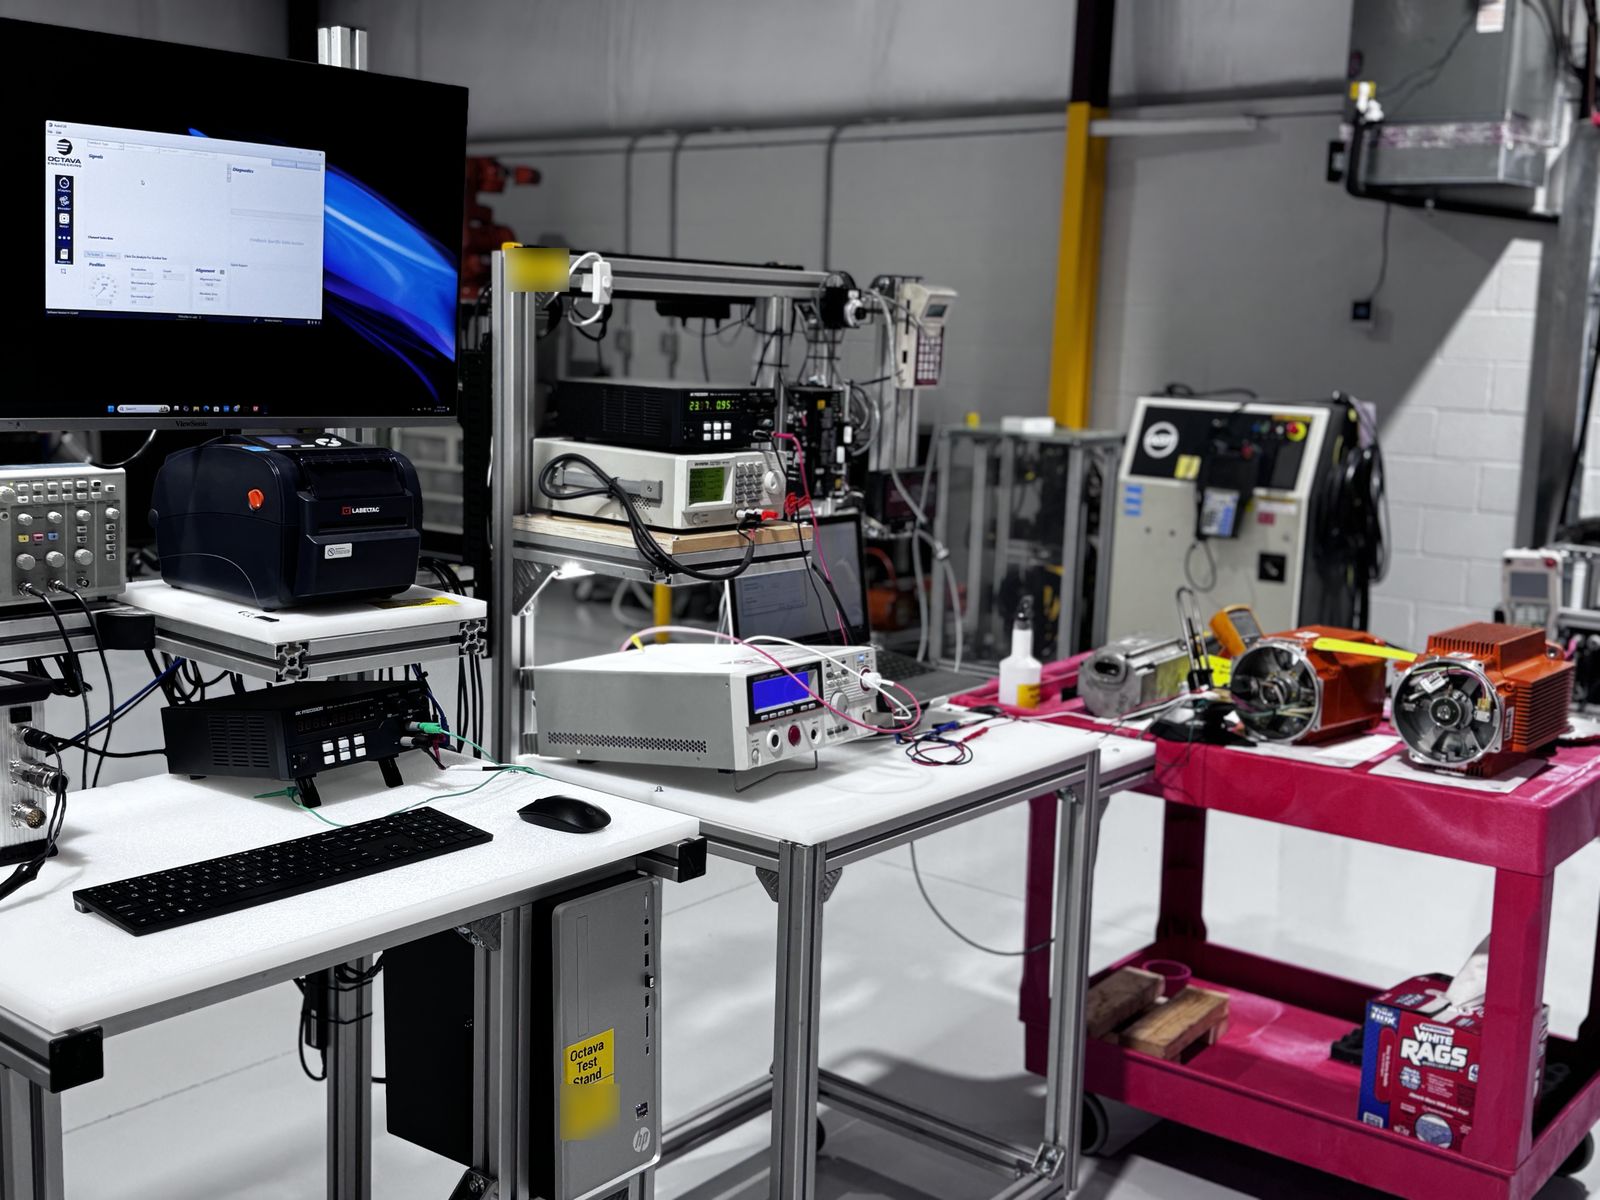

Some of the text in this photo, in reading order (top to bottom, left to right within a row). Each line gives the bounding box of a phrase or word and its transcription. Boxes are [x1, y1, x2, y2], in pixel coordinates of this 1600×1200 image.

[48, 156, 82, 164] OCTAVA
[176, 420, 209, 428] ViewSonic
[1413, 1026, 1453, 1046] WHITE
[570, 1041, 604, 1062] Octava
[1400, 1038, 1468, 1068] RAGS
[577, 1056, 597, 1073] Test
[573, 1066, 602, 1084] Stand
[633, 1127, 650, 1153] hp
